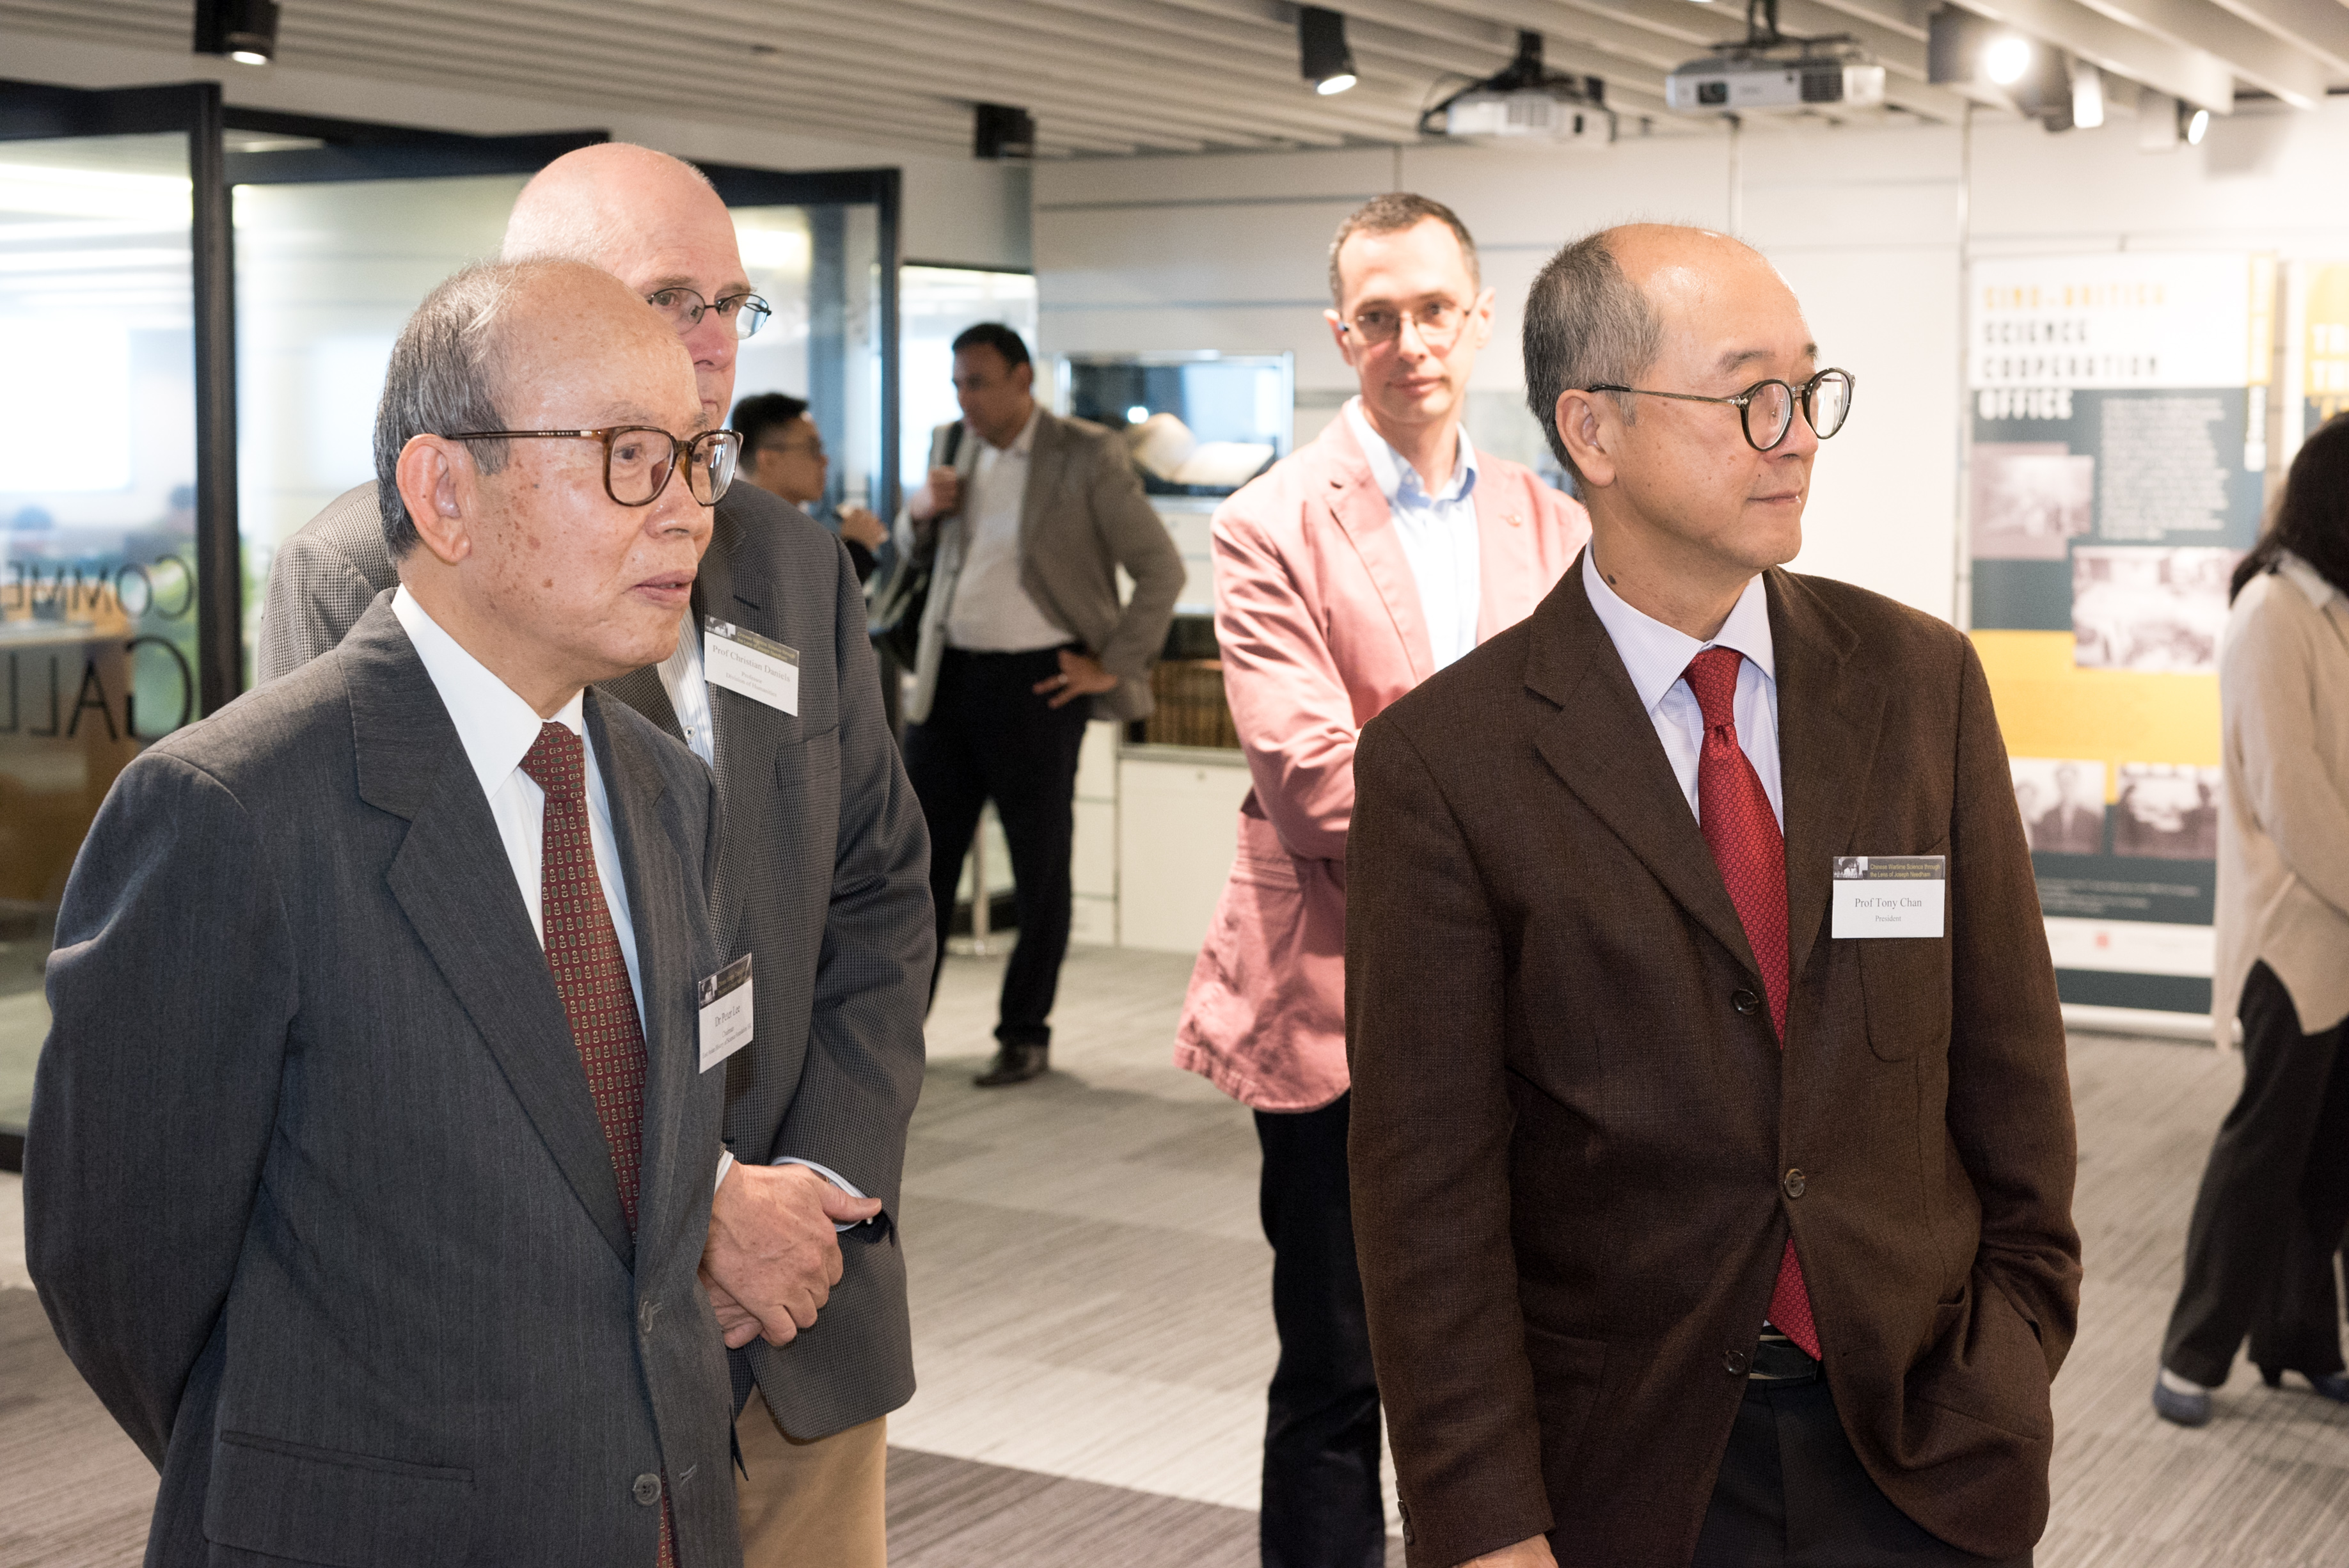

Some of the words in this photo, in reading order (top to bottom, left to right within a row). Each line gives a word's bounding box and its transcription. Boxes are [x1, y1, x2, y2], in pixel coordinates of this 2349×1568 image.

[1983, 319, 2089, 344] SCIENCE
[1982, 354, 2159, 379] COOPERATION
[1980, 387, 2073, 419] OFFICE
[713, 645, 729, 657] Prof
[730, 651, 763, 671] Christian
[764, 665, 791, 682] Daniels
[725, 672, 746, 685] Division
[741, 671, 763, 684] Professor
[1855, 898, 1874, 907] Prof
[1875, 898, 1898, 909] Tony
[1900, 898, 1922, 907] Chan
[715, 1016, 721, 1027] Dr
[722, 1011, 732, 1023] Peter
